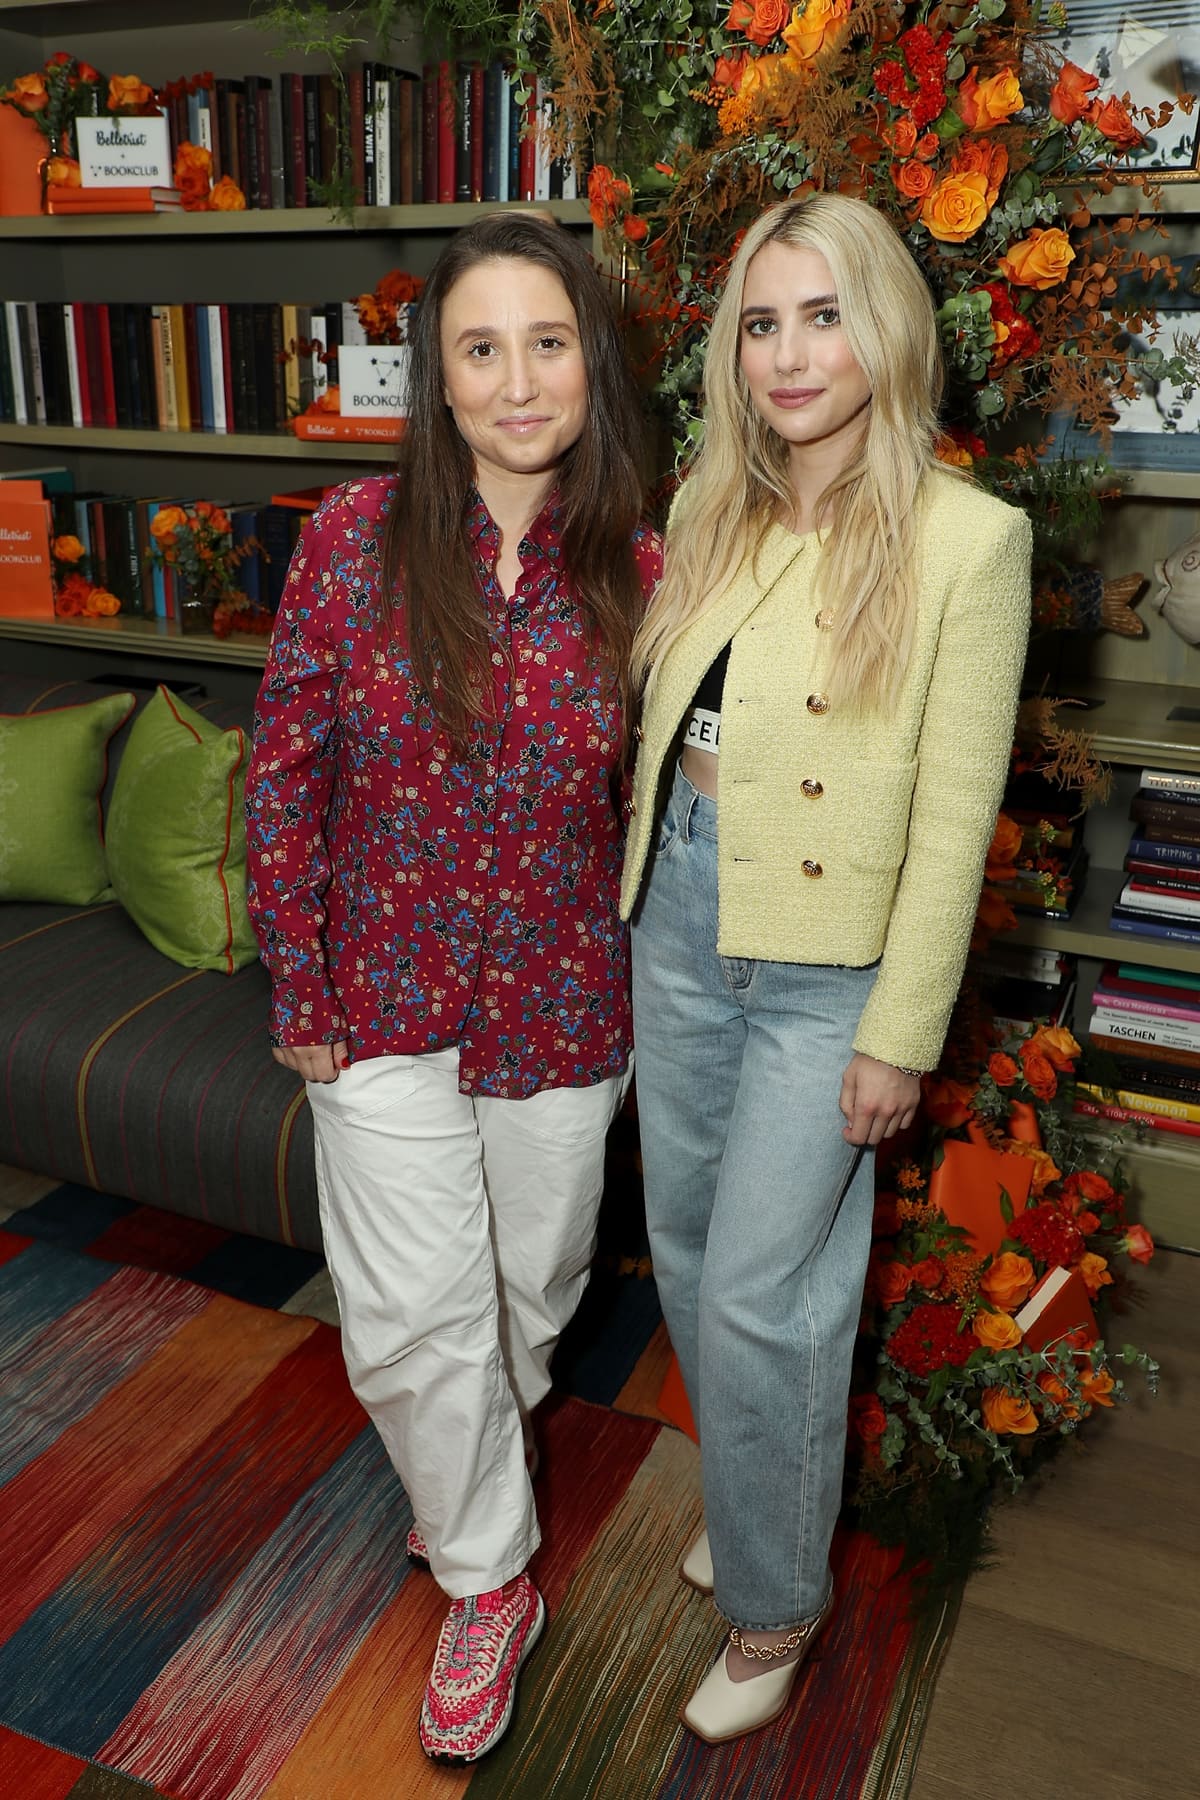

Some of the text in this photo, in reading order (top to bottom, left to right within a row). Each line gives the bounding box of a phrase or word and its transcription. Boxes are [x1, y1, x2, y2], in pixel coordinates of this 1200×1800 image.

[365, 134, 374, 163] WIFE
[104, 165, 159, 177] BOOKCLUB
[353, 394, 411, 407] BOOKCLU
[1155, 846, 1192, 861] TRIPPING
[1109, 1024, 1156, 1041] TASCHEN
[1124, 1093, 1189, 1119] Newman
